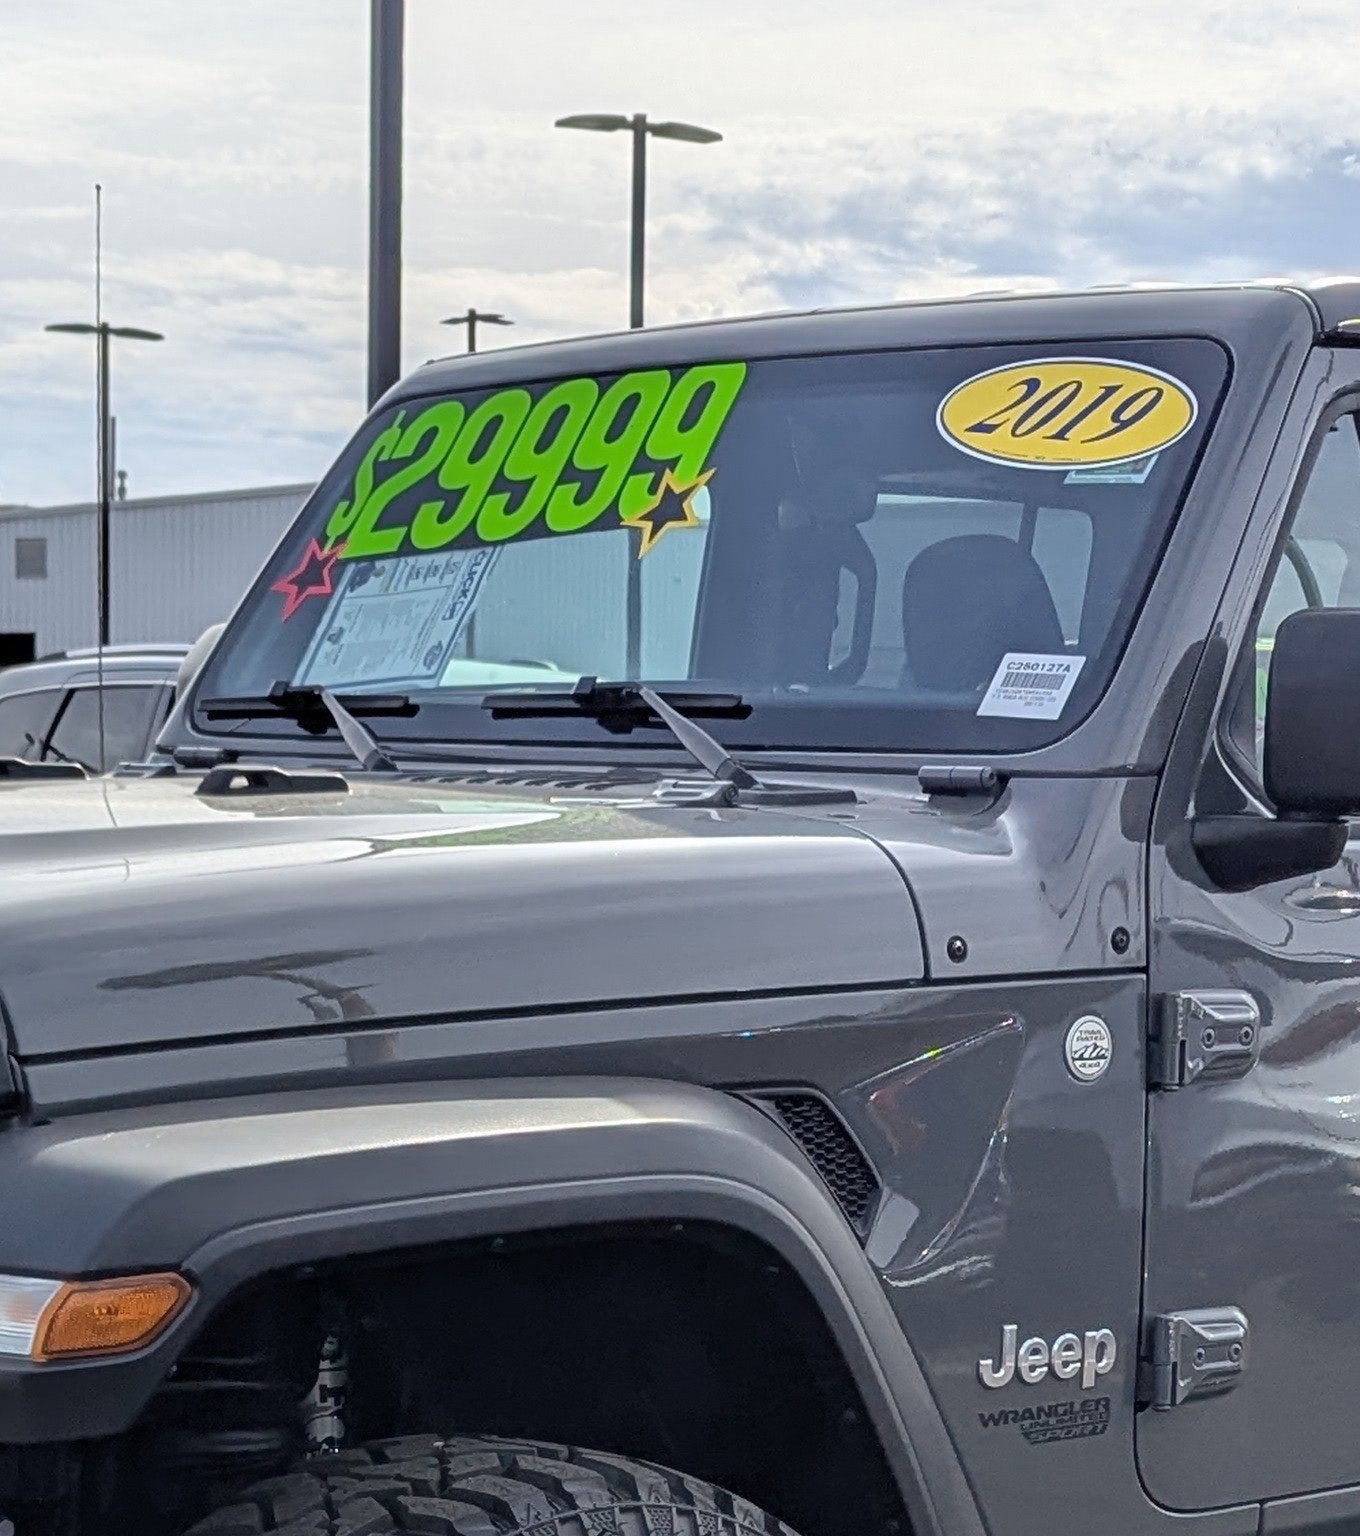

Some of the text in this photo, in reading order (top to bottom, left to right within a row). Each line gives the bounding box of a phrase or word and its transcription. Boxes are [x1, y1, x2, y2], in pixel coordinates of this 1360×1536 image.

[964, 377, 1164, 443] 2019
[324, 362, 747, 558] $29999
[979, 1324, 1117, 1389] Jeep
[978, 1396, 1111, 1428] WRANGLER
